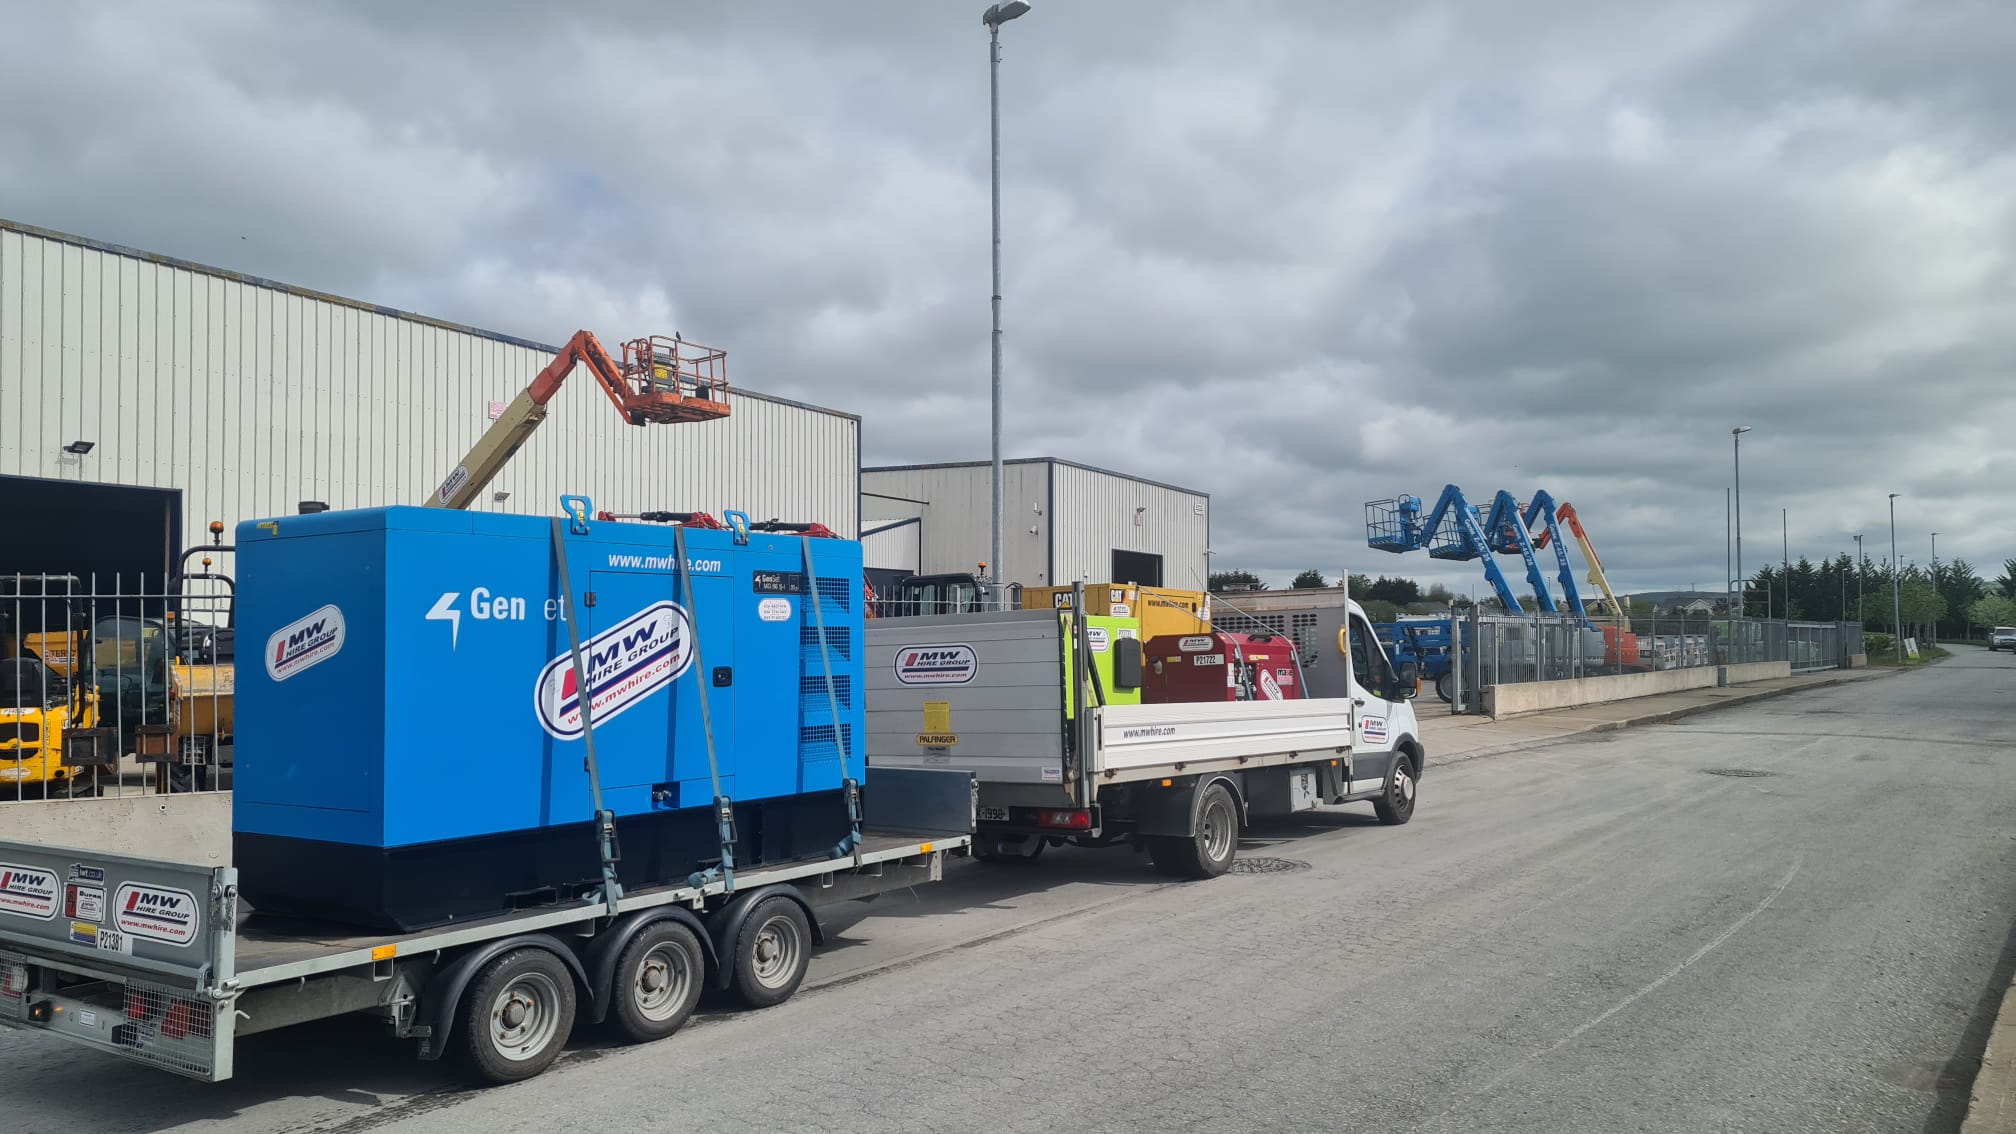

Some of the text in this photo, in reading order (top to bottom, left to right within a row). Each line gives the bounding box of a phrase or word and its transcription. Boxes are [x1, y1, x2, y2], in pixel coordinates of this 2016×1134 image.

[470, 586, 526, 621] Gen
[286, 626, 338, 658] HIRE GROUP
[288, 617, 327, 649] MW
[587, 619, 658, 675] MW
[919, 650, 961, 661] MW
[277, 642, 335, 674] www.mwhire.com
[584, 626, 680, 688] HIRE GROUP
[1195, 655, 1217, 665] P21722
[919, 735, 956, 744] PALFINGER
[12, 872, 47, 886] MW
[8, 884, 54, 896] HIRE GROUP
[139, 893, 182, 909] MW
[136, 905, 190, 920] HIRE GROUP
[121, 919, 187, 937] www.mwhire.com
[100, 931, 123, 952] P21381
